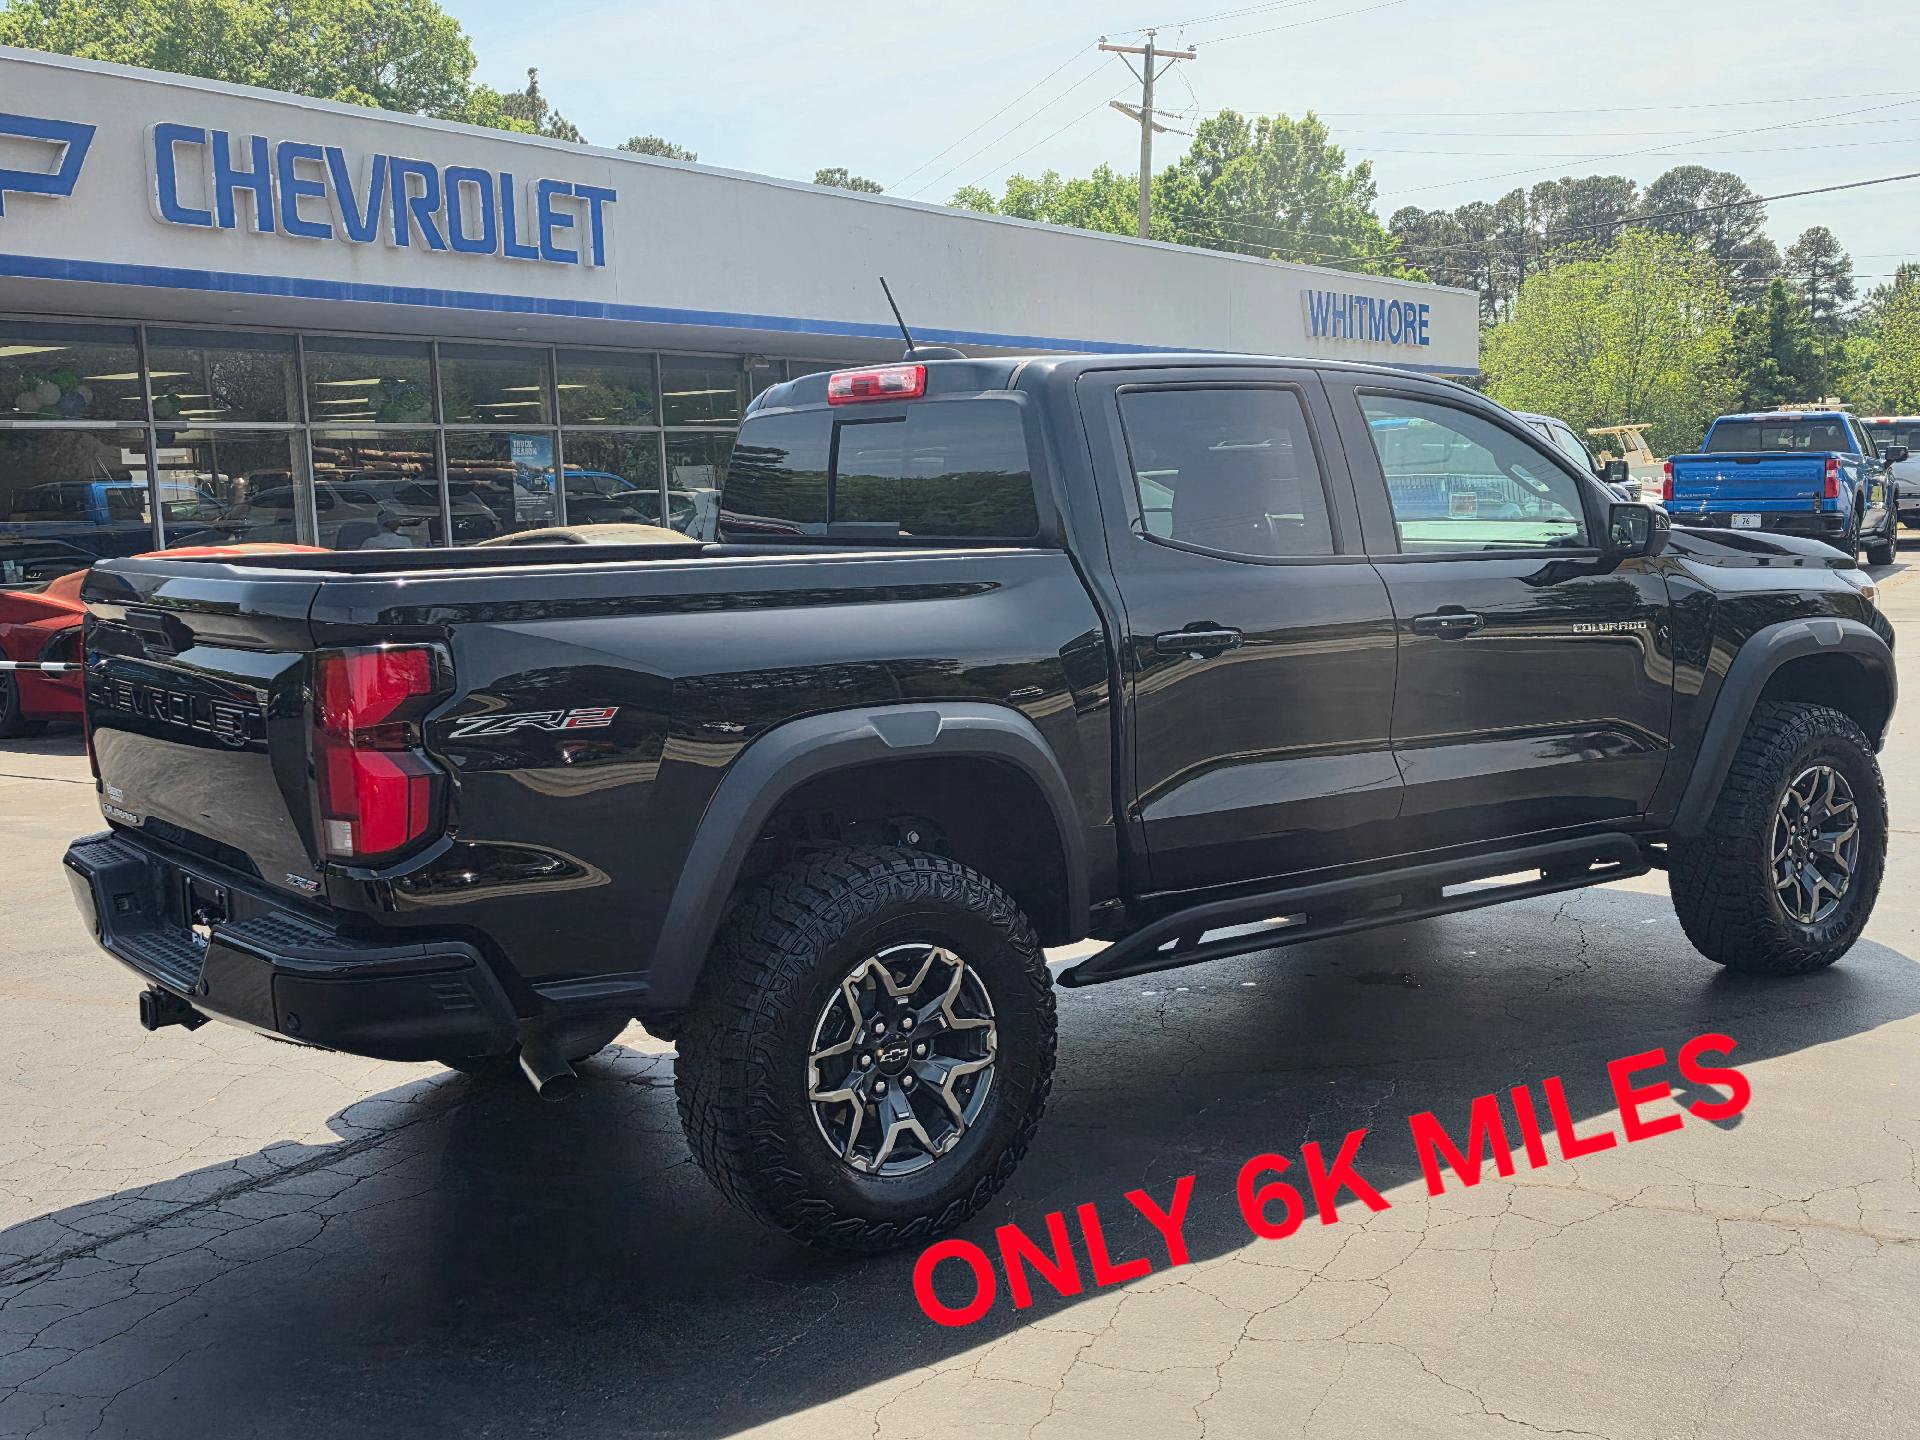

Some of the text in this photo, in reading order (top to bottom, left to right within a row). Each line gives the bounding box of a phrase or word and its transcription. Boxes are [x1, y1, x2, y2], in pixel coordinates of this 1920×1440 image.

[146, 121, 617, 268] CHEVROLET
[1305, 289, 1431, 346] WHITMORE
[512, 440, 533, 448] TRUCK
[512, 447, 538, 456] SEASON
[1572, 621, 1647, 633] COLORADO
[448, 706, 620, 739] ZR2
